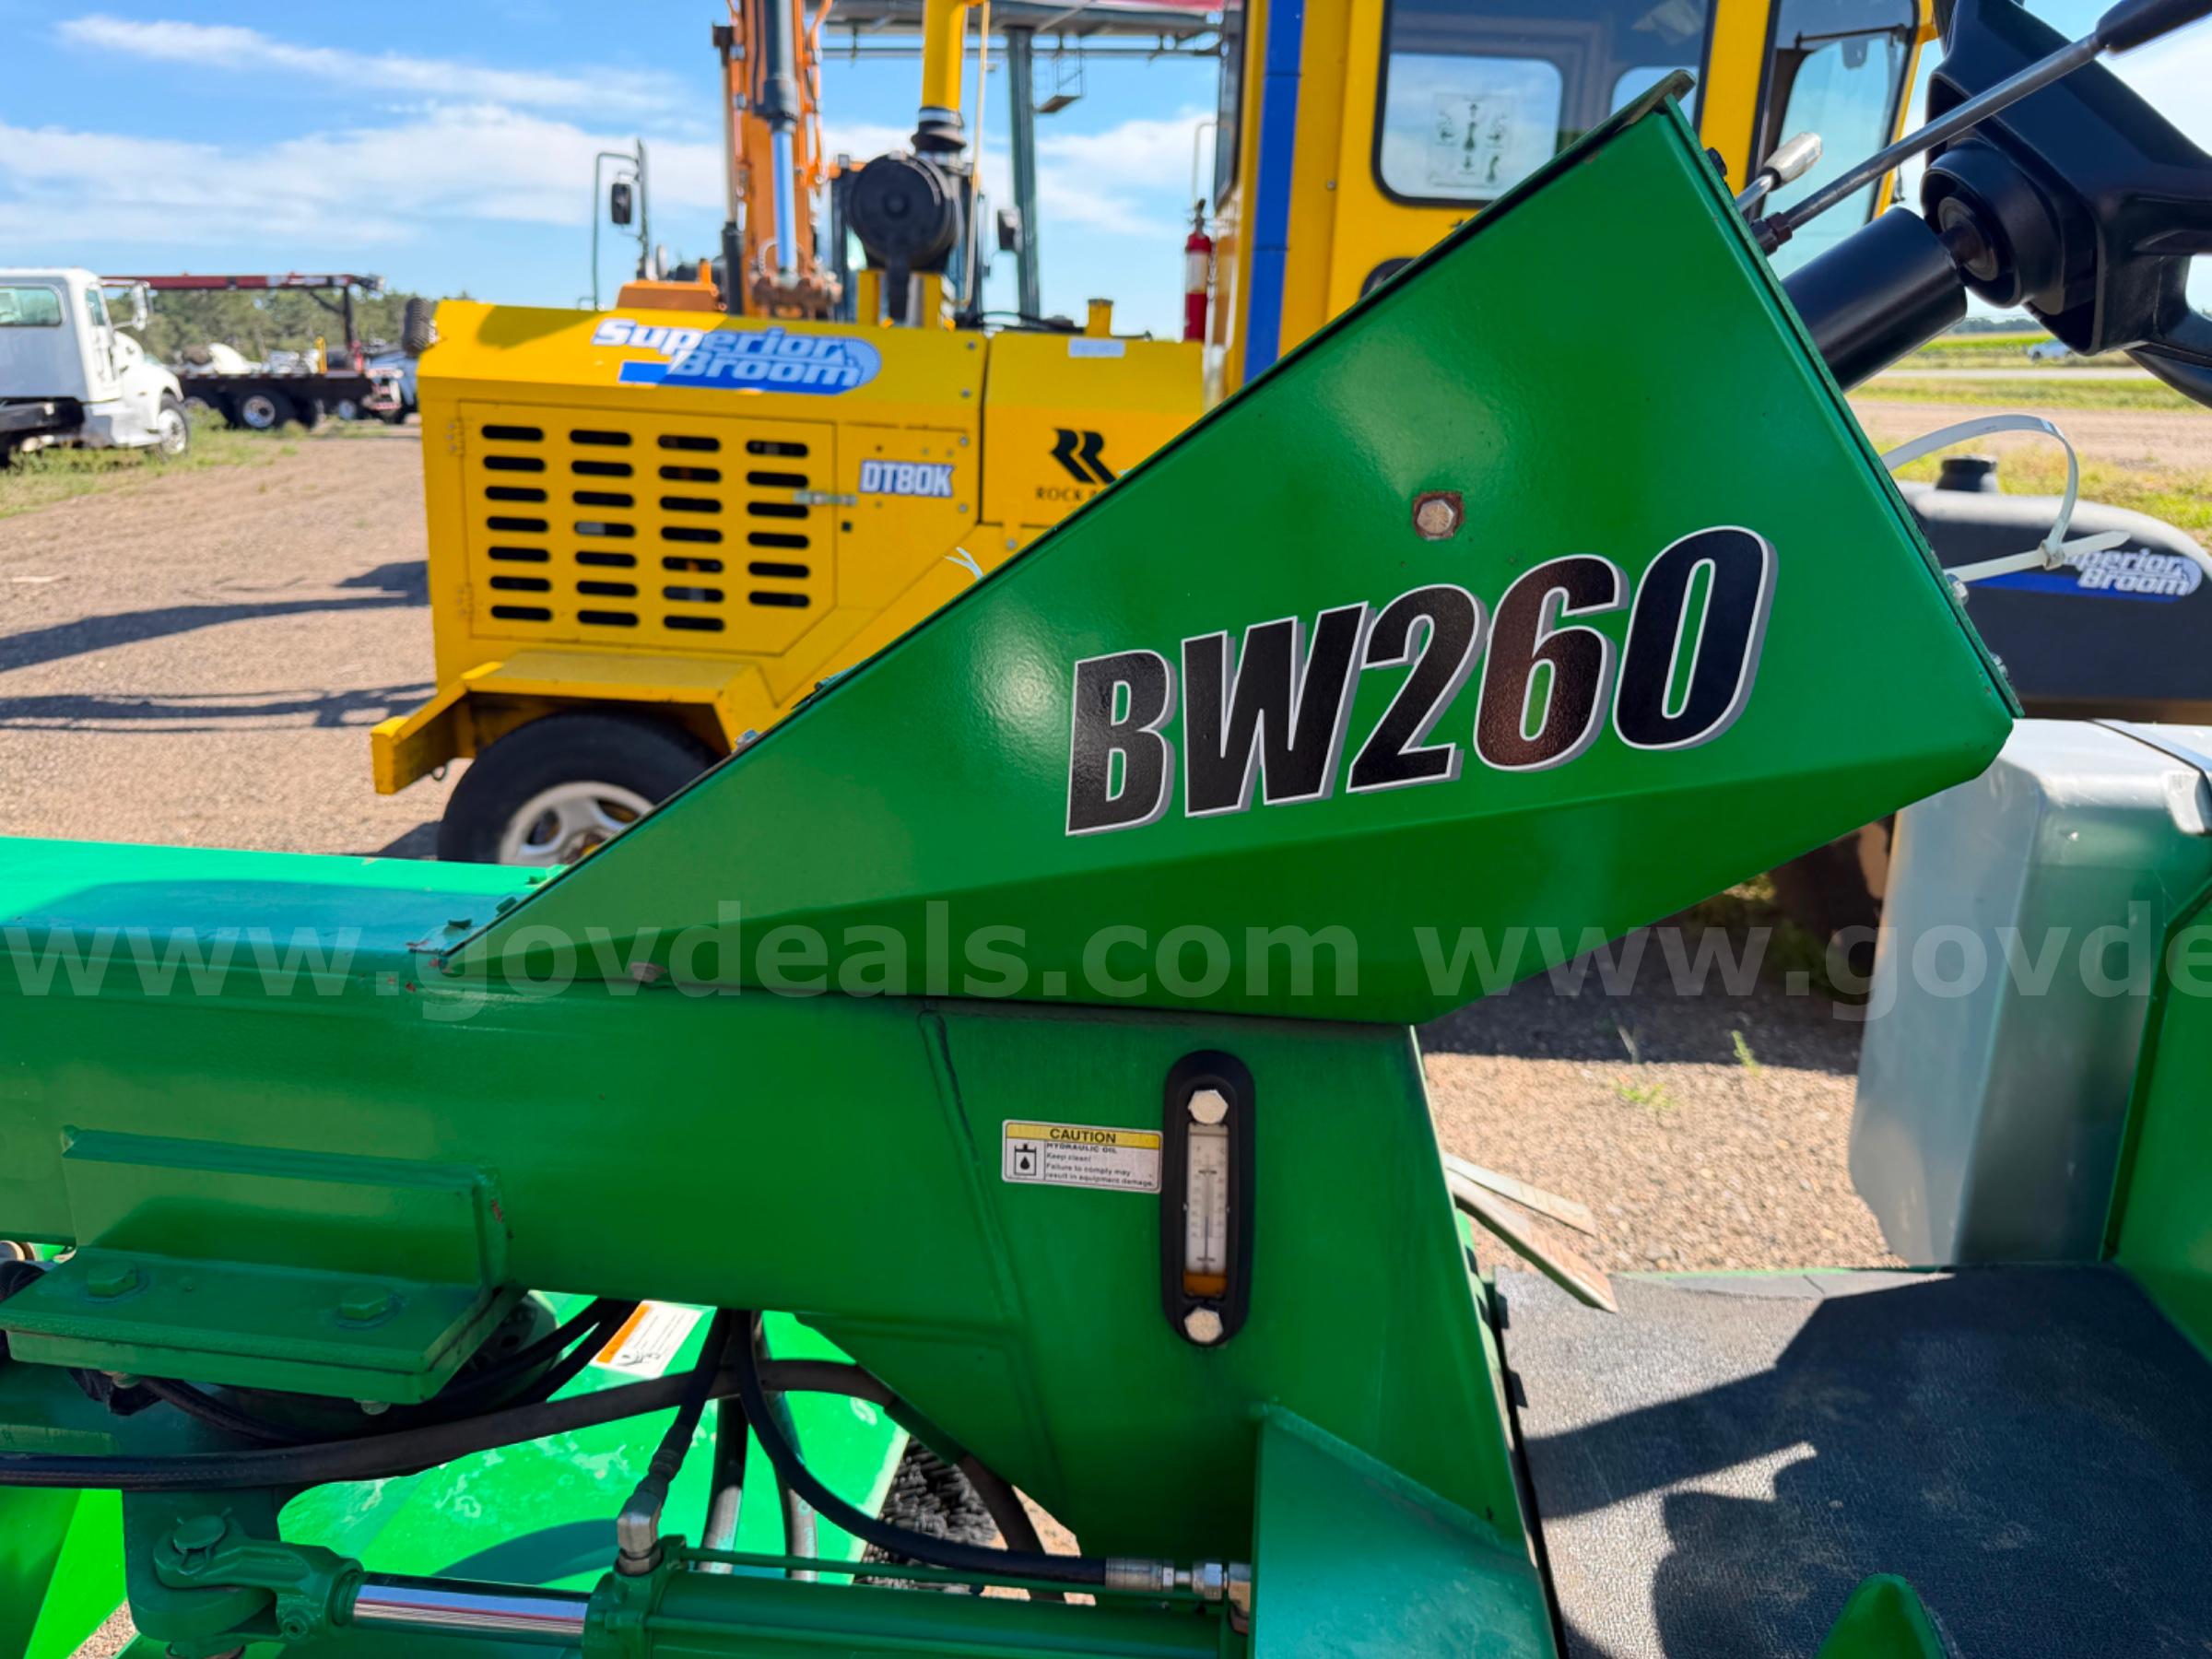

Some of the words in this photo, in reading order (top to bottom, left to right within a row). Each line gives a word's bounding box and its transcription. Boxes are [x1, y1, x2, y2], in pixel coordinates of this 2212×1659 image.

[590, 318, 842, 360] Superior
[667, 349, 861, 387] Broom
[860, 460, 954, 498] DT80K
[1035, 486, 1083, 502] ROCK
[2065, 547, 2183, 576] perior
[2077, 567, 2191, 596] Broom
[1065, 525, 1778, 836] BW260
[1049, 1128, 1116, 1144] CAUTION
[1046, 1143, 1099, 1153] HYDRAULIC
[1046, 1152, 1067, 1161] Keep
[1046, 1162, 1072, 1171] Failure
[1084, 1166, 1112, 1175] comply
[1114, 1170, 1131, 1178] may
[1046, 1171, 1068, 1180] result
[1079, 1175, 1120, 1184] equipment
